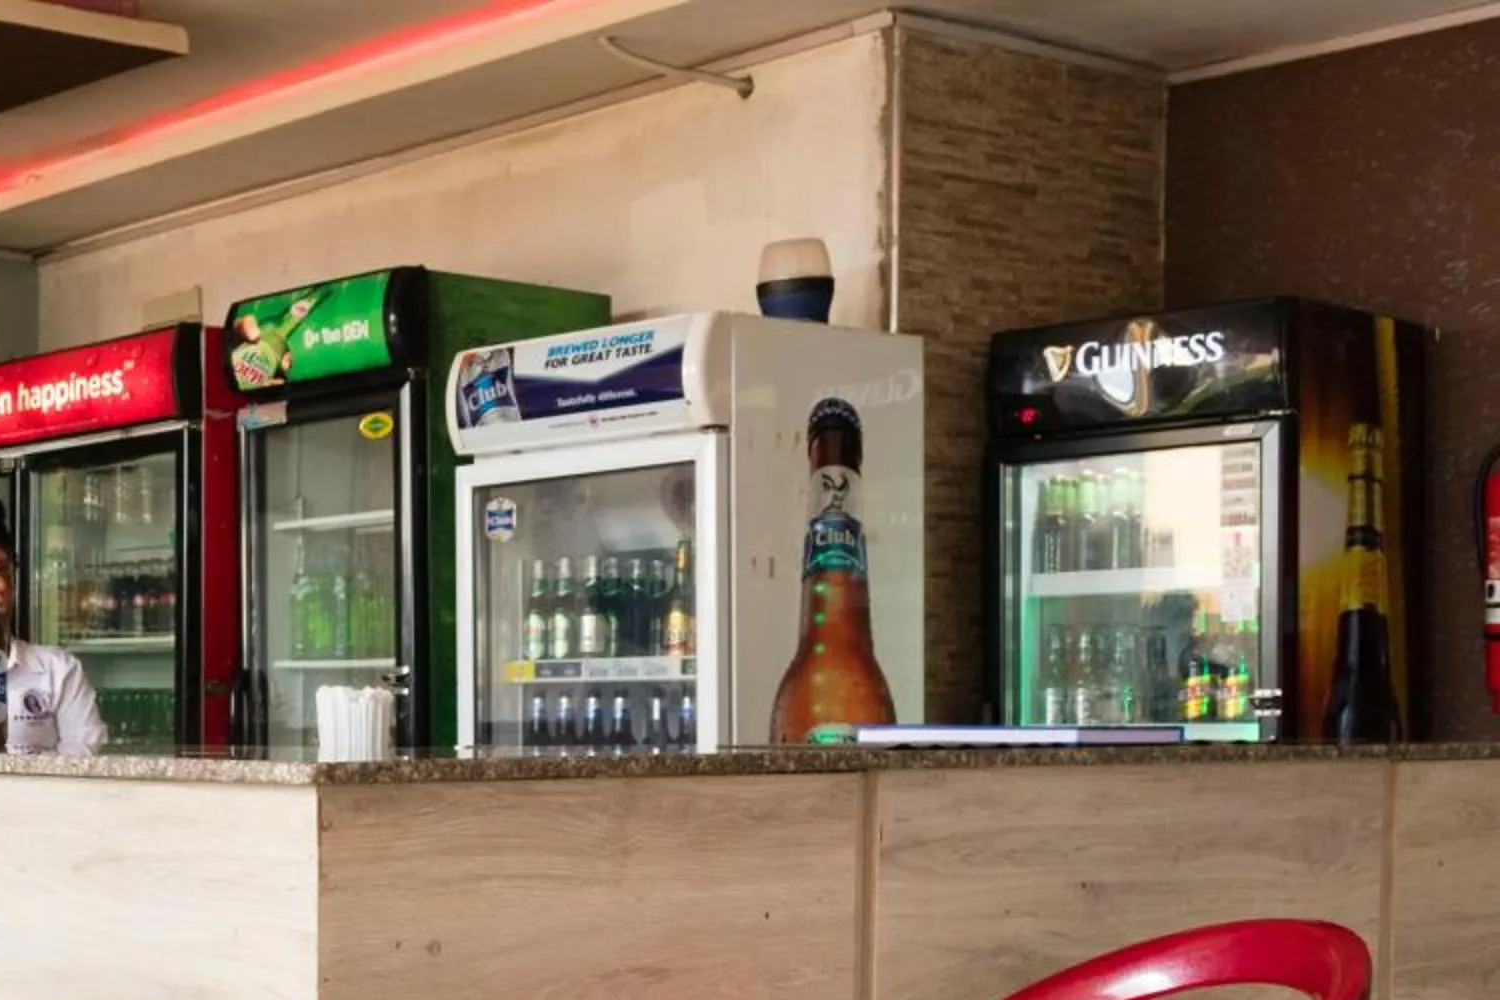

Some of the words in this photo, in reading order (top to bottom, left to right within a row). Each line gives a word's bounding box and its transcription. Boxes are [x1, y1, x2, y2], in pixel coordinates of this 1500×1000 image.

[547, 340, 599, 357] BREWED
[601, 328, 655, 348] LONGER
[1075, 331, 1224, 375] GUINNESS
[544, 356, 569, 370] FOR
[571, 350, 612, 365] GREAT
[17, 368, 124, 414] happiness
[467, 383, 509, 412] Club
[815, 528, 855, 548] Club
